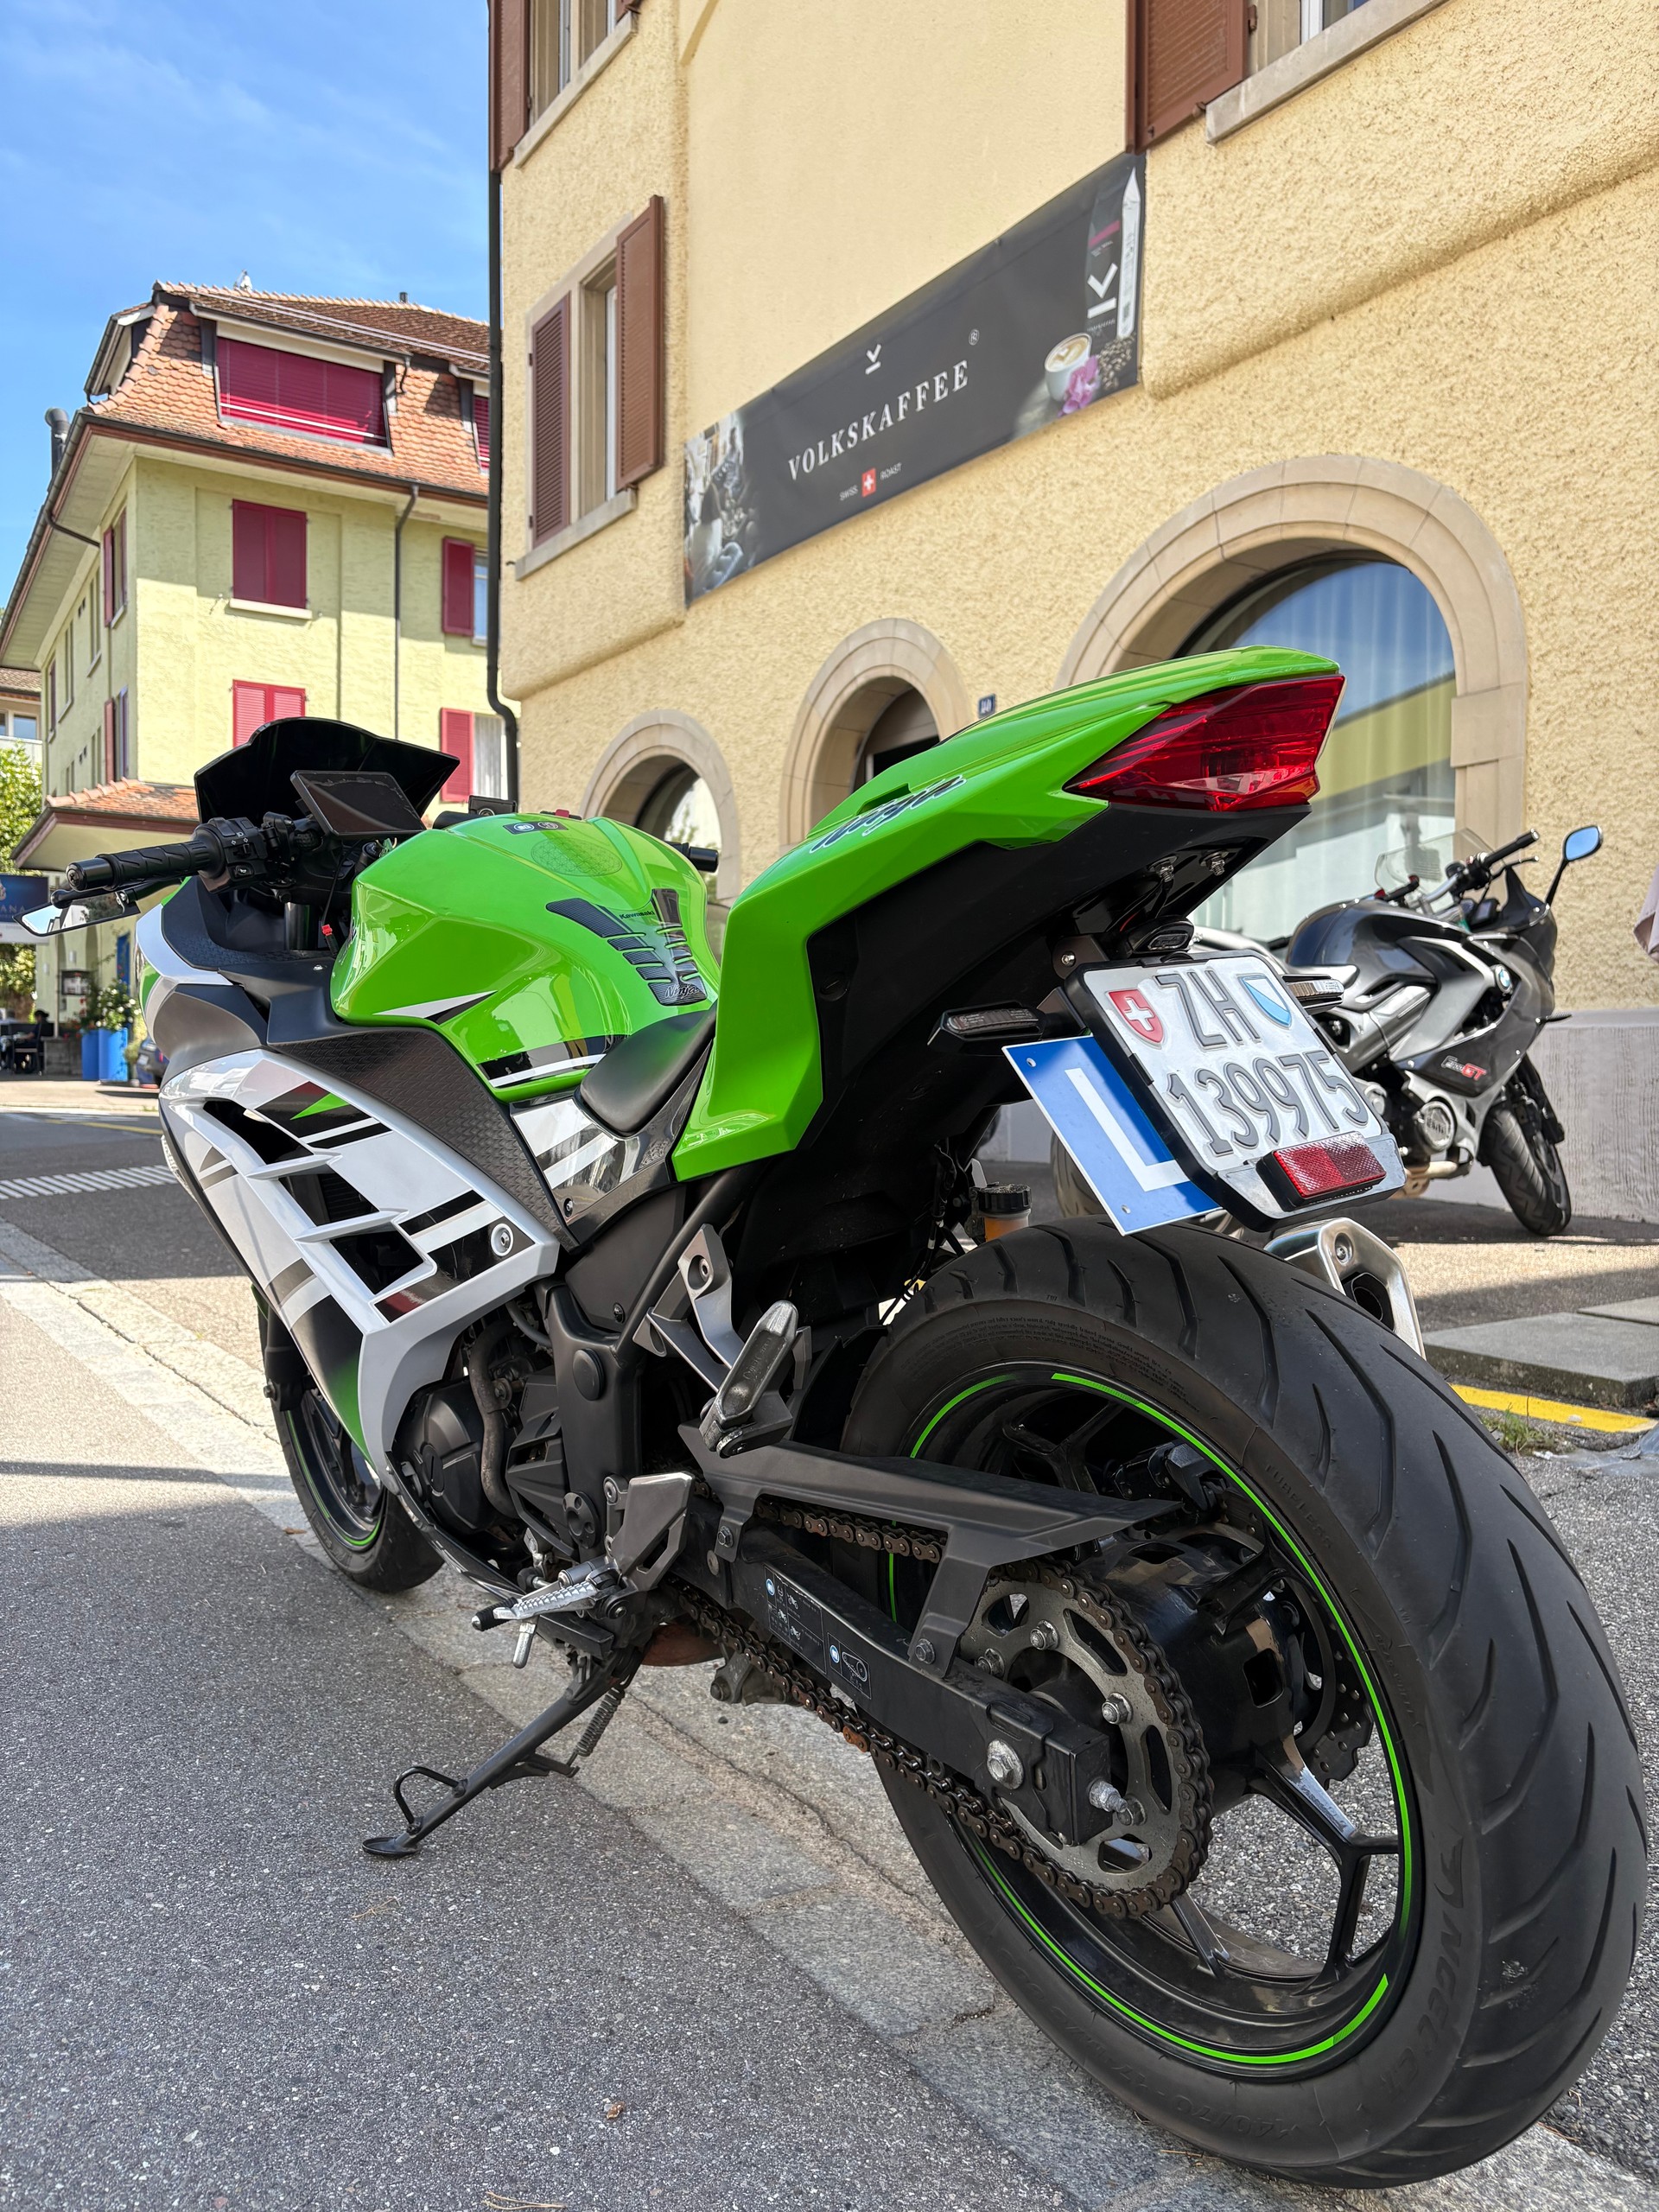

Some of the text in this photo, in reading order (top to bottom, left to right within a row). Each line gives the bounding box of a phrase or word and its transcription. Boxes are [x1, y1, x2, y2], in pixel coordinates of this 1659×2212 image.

[788, 359, 969, 481] VOLKSKAFFEE
[839, 485, 859, 500] SWISS
[619, 910, 655, 919] Kawasaki
[664, 983, 700, 999] Ninja
[1154, 969, 1262, 1050] ZH
[1065, 1068, 1190, 1192] L
[1166, 1049, 1370, 1156] 139975
